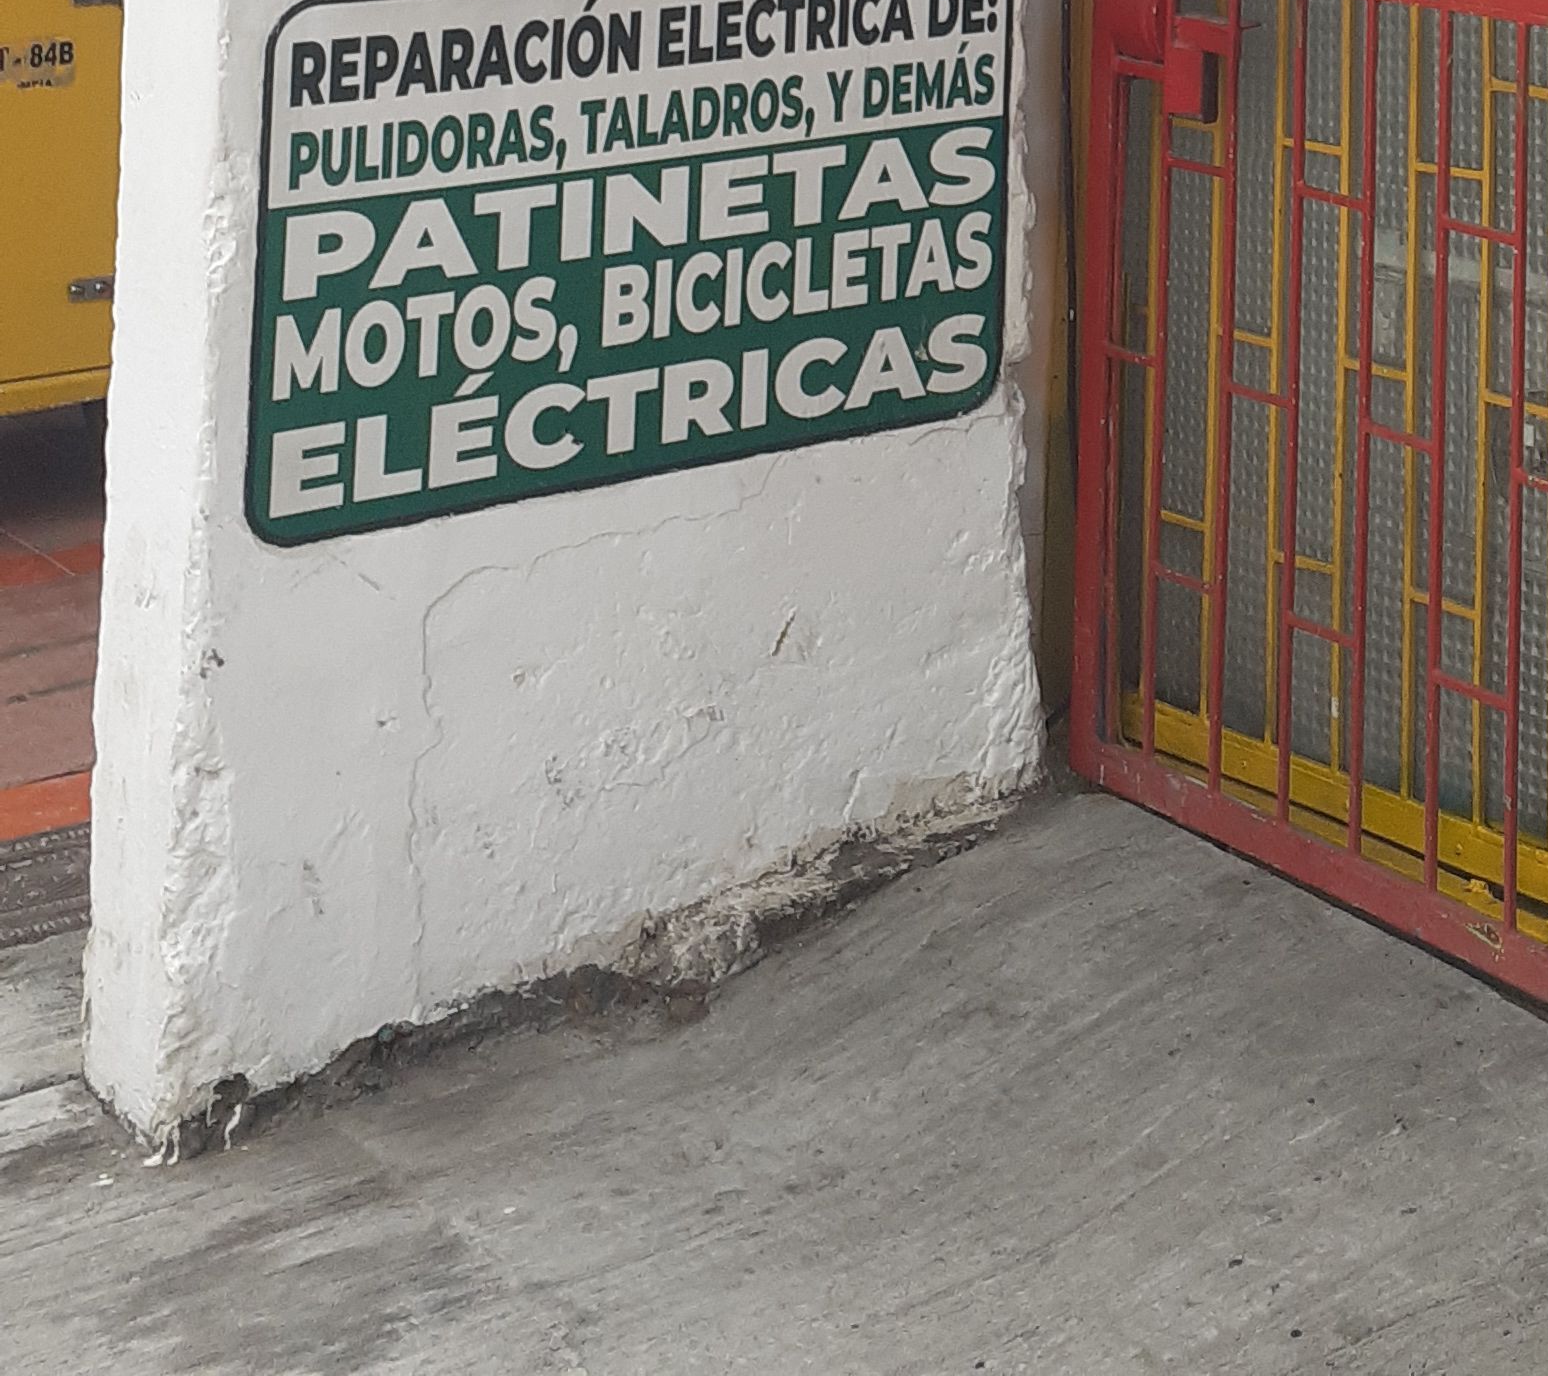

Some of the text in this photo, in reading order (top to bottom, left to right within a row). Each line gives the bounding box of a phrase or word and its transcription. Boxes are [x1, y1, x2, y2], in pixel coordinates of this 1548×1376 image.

[288, 42, 995, 190] PULIDORAS, TALADROS, Y DEMÁS
[282, 127, 996, 302] PATINETAS
[271, 211, 993, 403] MOTOS, BICICLETAS
[269, 313, 988, 519] ELÉCTRICAS
